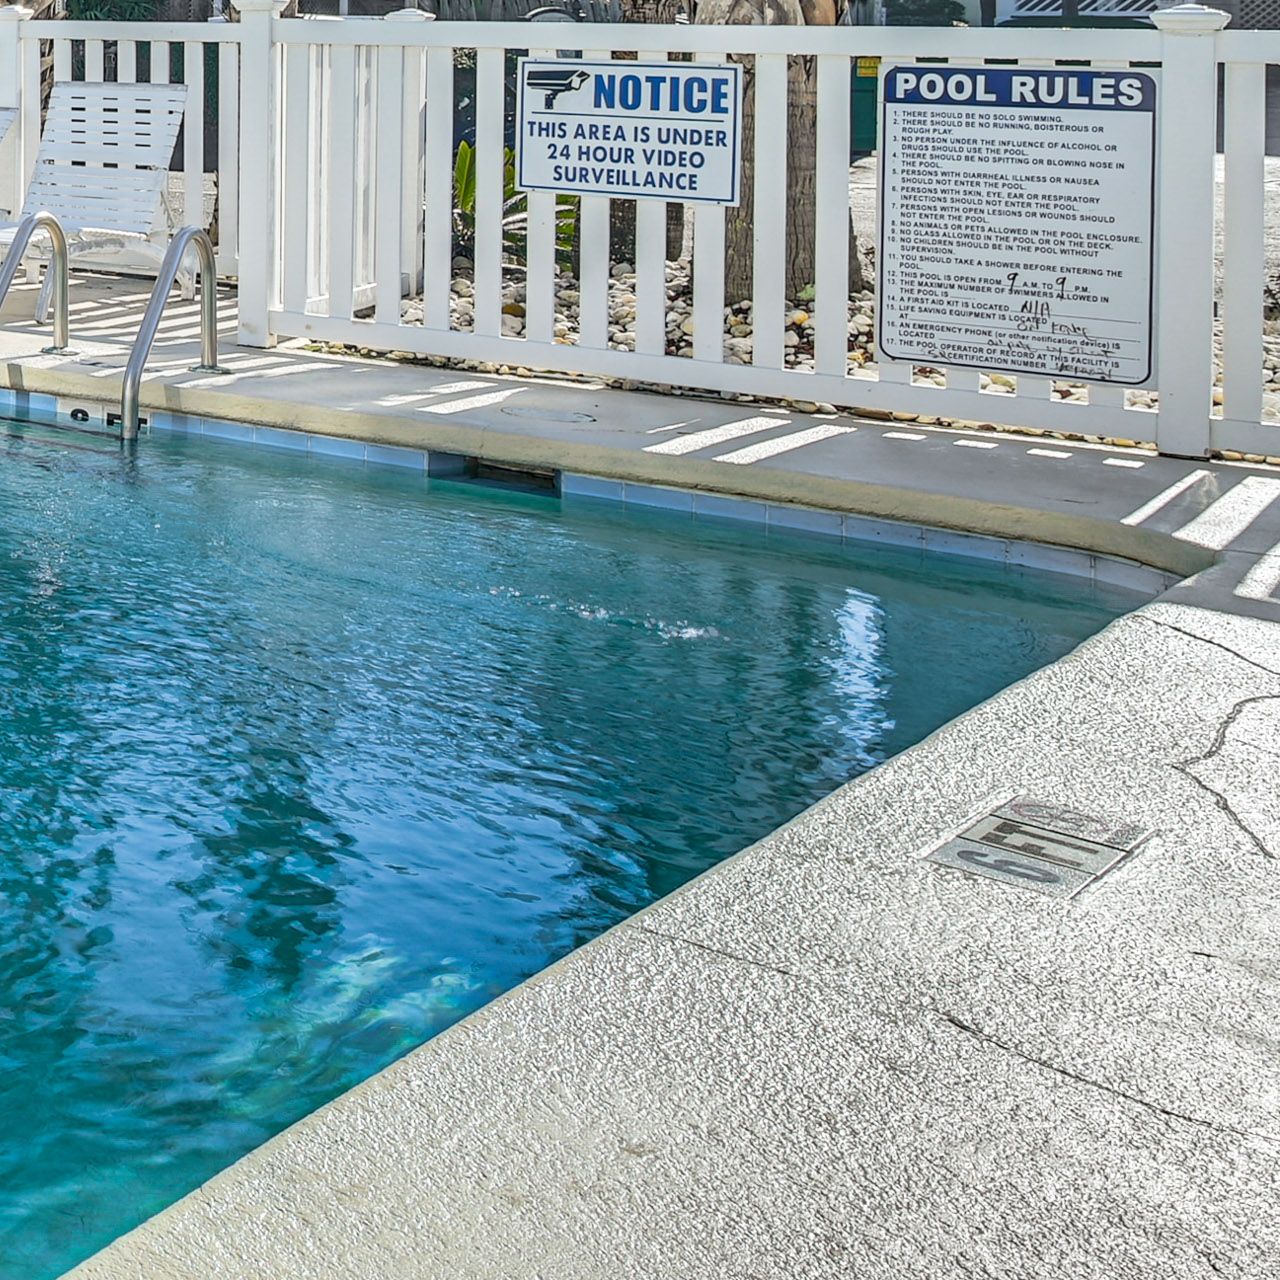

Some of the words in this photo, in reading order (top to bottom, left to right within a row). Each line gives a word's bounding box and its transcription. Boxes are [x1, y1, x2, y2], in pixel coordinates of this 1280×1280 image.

[593, 74, 729, 114] NOTICE
[895, 72, 998, 102] POOL
[1012, 76, 1143, 107] RULES
[992, 122, 1032, 130] RUNNING,
[1033, 124, 1089, 132] BOISTEROUS
[1017, 115, 1064, 123] SWIMMING.
[528, 121, 567, 139] THIS
[573, 124, 627, 142] AREA
[634, 126, 651, 143] IS
[658, 128, 728, 147] UNDER
[901, 126, 930, 134] ROUGH
[901, 143, 929, 151] DRUGS
[931, 145, 964, 153] SHOULD
[1003, 148, 1027, 156] POOL.
[914, 135, 947, 143] PERSON
[949, 137, 977, 145] UNDER
[998, 139, 1044, 148] INFLUENCE
[1060, 143, 1100, 151] ALCOHOL
[547, 143, 571, 160] 24
[578, 146, 635, 164] HOUR
[642, 149, 705, 169] VIDEO
[991, 156, 1029, 164] SPITTING
[1046, 159, 1086, 167] BLOWING
[1088, 161, 1113, 169] NOSE
[553, 165, 698, 191] SURVEILLANCE
[900, 168, 938, 176] PERSONS
[962, 172, 1008, 180] DIARRHEAL
[1011, 174, 1046, 182] ILLNESS
[1064, 177, 1099, 185] NAUSEA
[901, 176, 933, 184] SHOULD
[953, 179, 980, 187] ENTER
[1001, 182, 1026, 190] POOL.
[900, 185, 938, 194] PERSONS
[986, 190, 1004, 198] EYE,
[1041, 194, 1099, 204] RESPIRATORY
[900, 202, 937, 211] PERSONS
[961, 206, 984, 214] OPEN
[986, 208, 1022, 217] LESIONS
[1039, 212, 1077, 220] WOUNDS
[1079, 214, 1115, 223] SHOULD
[913, 221, 948, 229] ANIMALS
[964, 224, 985, 232] PETS
[987, 226, 1028, 235] ALLOWED
[1060, 231, 1082, 239] POOL
[1086, 233, 1142, 243] ENCLOSURE.
[918, 255, 951, 263] SHOULD
[954, 257, 974, 265] TAKE
[984, 260, 1020, 269] SHOWER
[1022, 263, 1057, 272] BEFORE
[1059, 266, 1103, 275] ENTERING
[919, 272, 940, 280] POOL
[953, 275, 976, 283] OPEN
[978, 277, 1002, 285] FROM
[1007, 272, 1019, 294] 9
[1056, 276, 1067, 299] 9
[898, 329, 935, 339] LOCATED
[912, 323, 961, 333] EMERGENCY
[964, 328, 992, 336] PHONE
[1031, 335, 1077, 345] notification
[1079, 340, 1109, 348] device)
[947, 352, 1008, 364] CERTIFICATION
[1010, 358, 1046, 368] NUMBER
[979, 822, 1100, 867] FT
